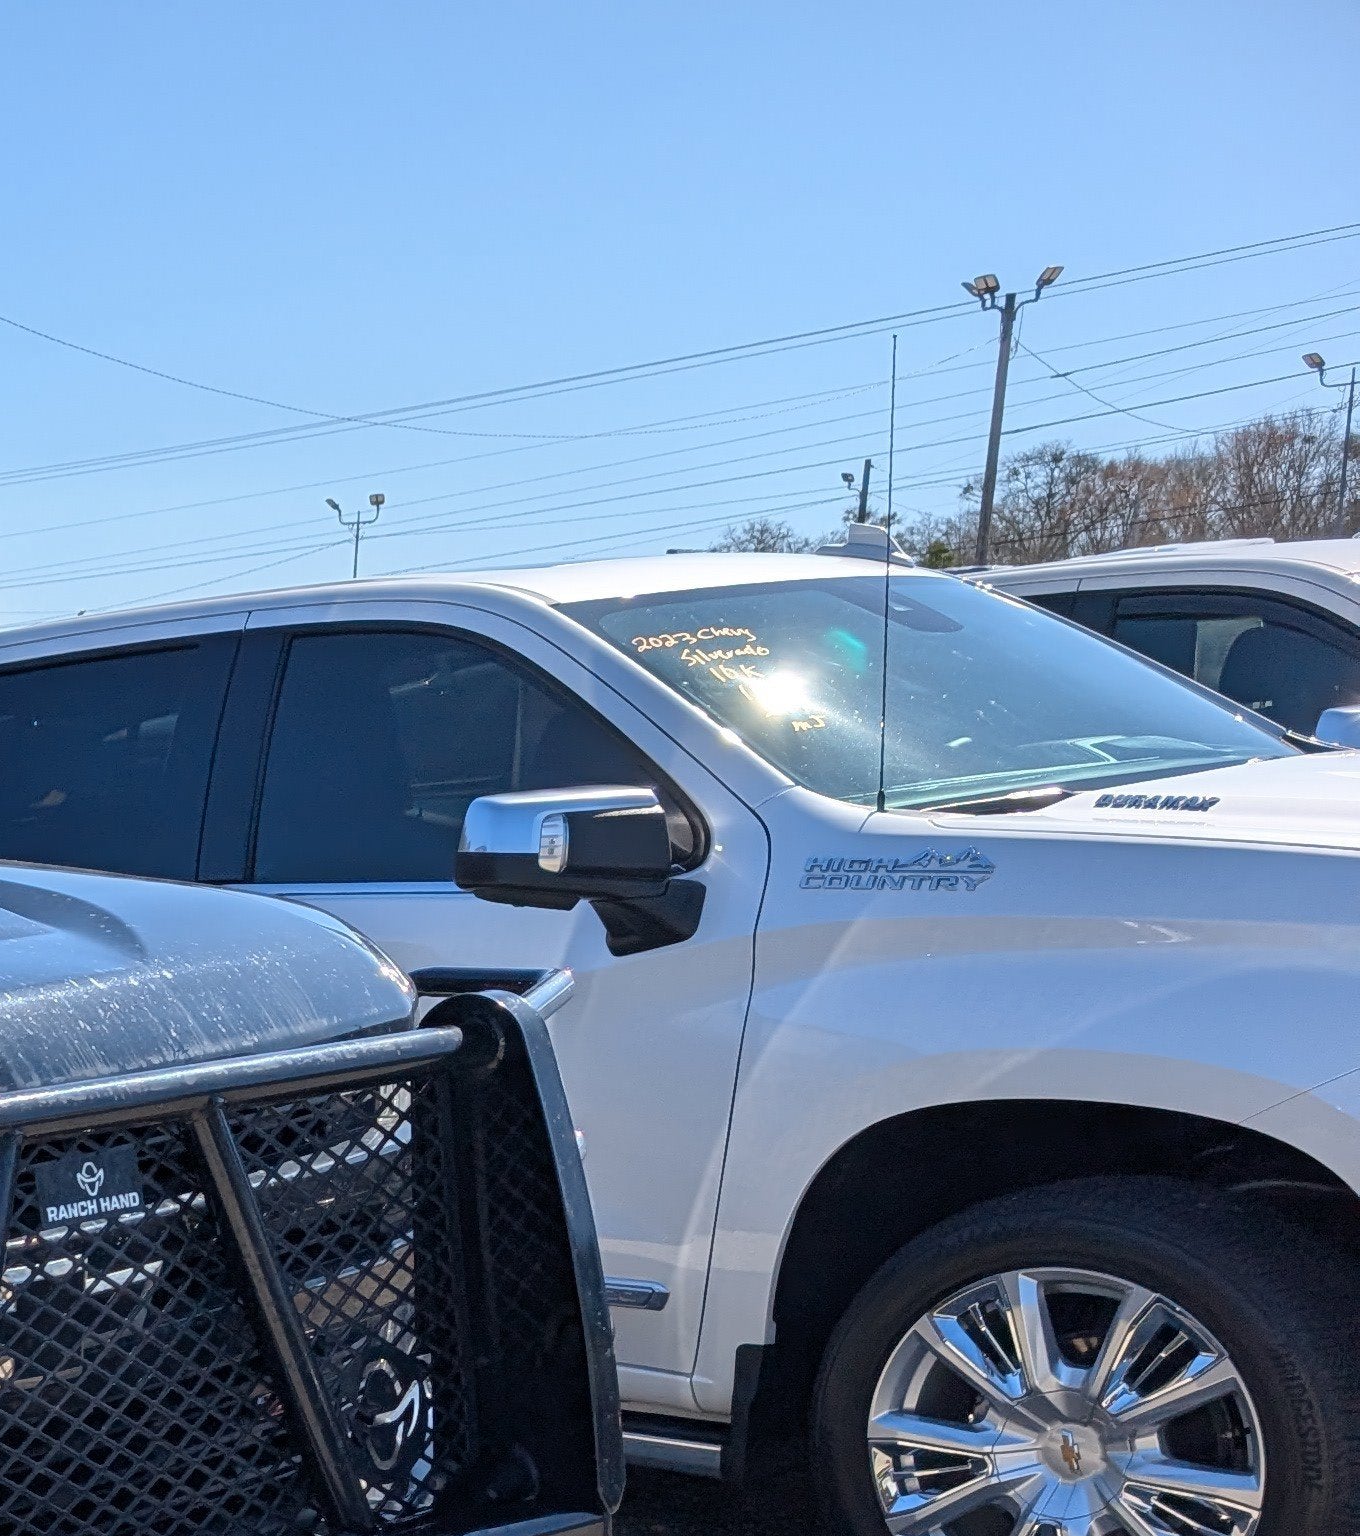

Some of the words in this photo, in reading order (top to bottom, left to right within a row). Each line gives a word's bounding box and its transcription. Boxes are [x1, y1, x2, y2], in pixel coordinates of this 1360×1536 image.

[632, 632, 697, 652] 2023
[697, 627, 757, 642] Chevy
[1093, 794, 1220, 812] DURAMAX
[804, 856, 898, 872] HIGH
[799, 874, 991, 891] COUNTRY
[46, 1199, 98, 1222] RANCH
[99, 1192, 140, 1212] HAND
